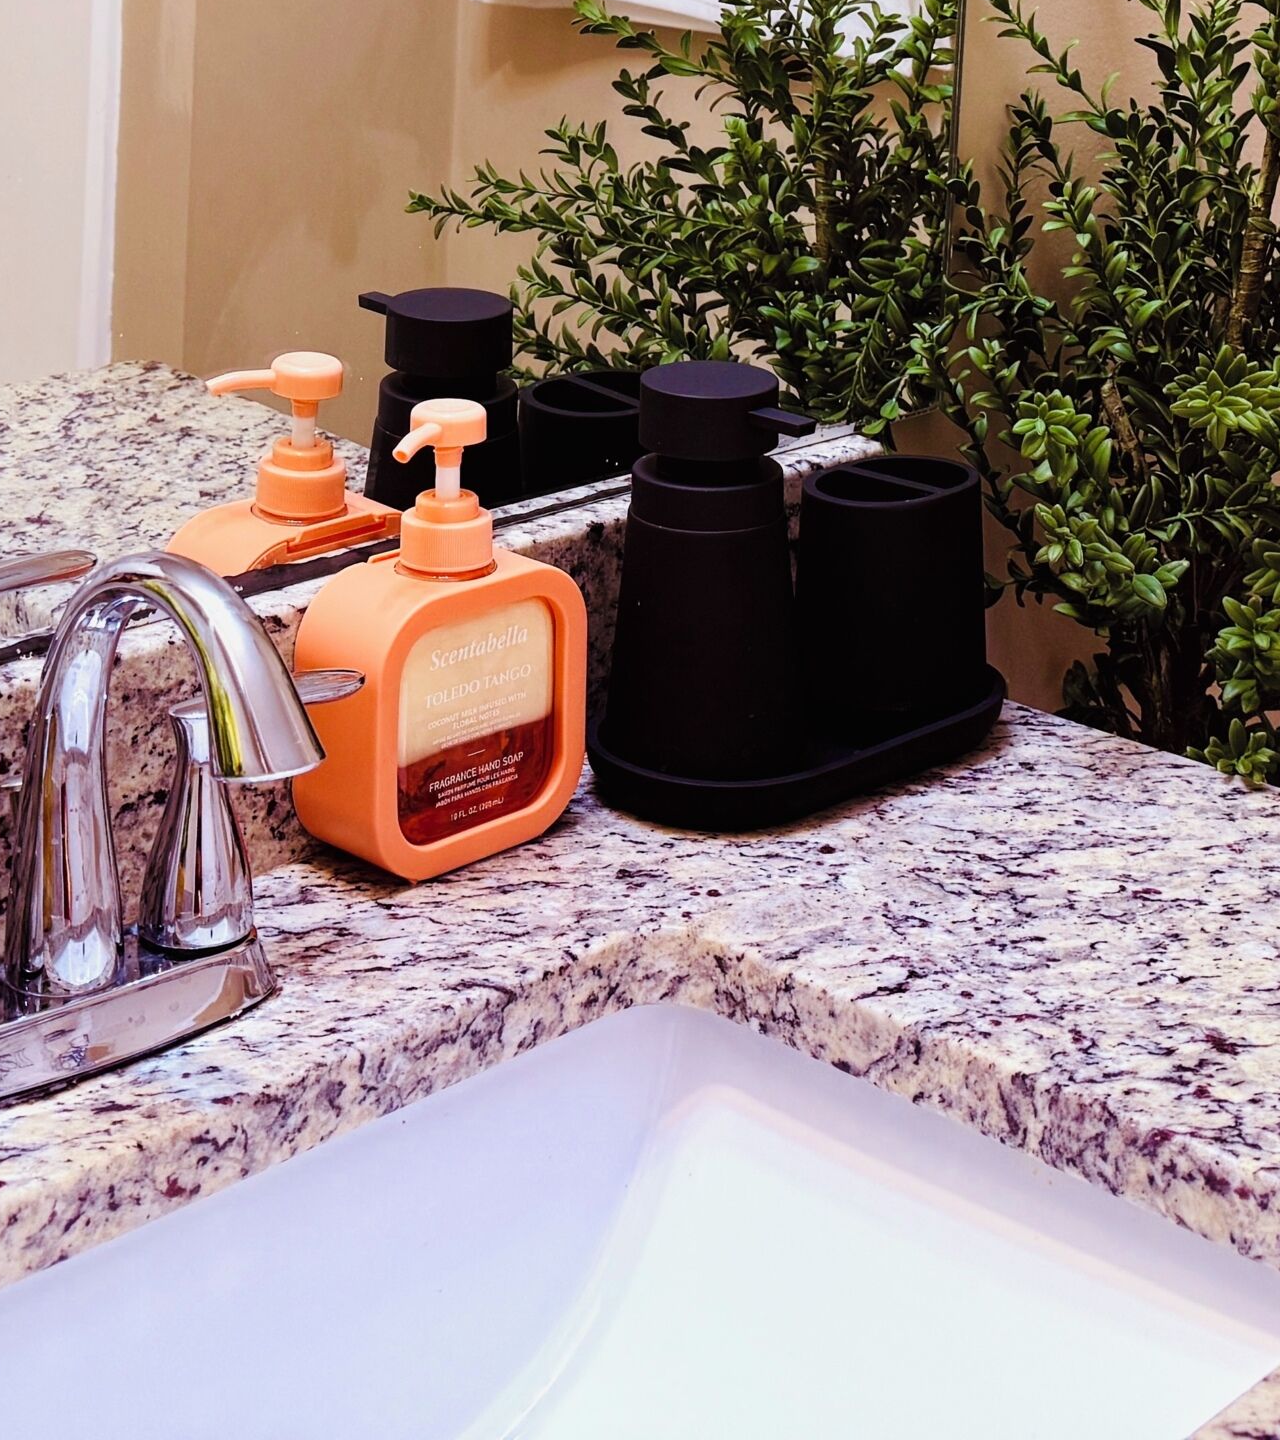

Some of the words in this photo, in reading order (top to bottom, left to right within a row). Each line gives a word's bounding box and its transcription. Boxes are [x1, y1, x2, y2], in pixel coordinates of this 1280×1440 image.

[430, 625, 528, 671] Scentabella
[425, 679, 480, 709] TOLEDO
[483, 664, 531, 689] TANGO
[428, 711, 460, 730] COCONUT
[429, 768, 477, 792] FRAGRANCE
[479, 760, 501, 774] HAND
[503, 752, 524, 765] SOAP
